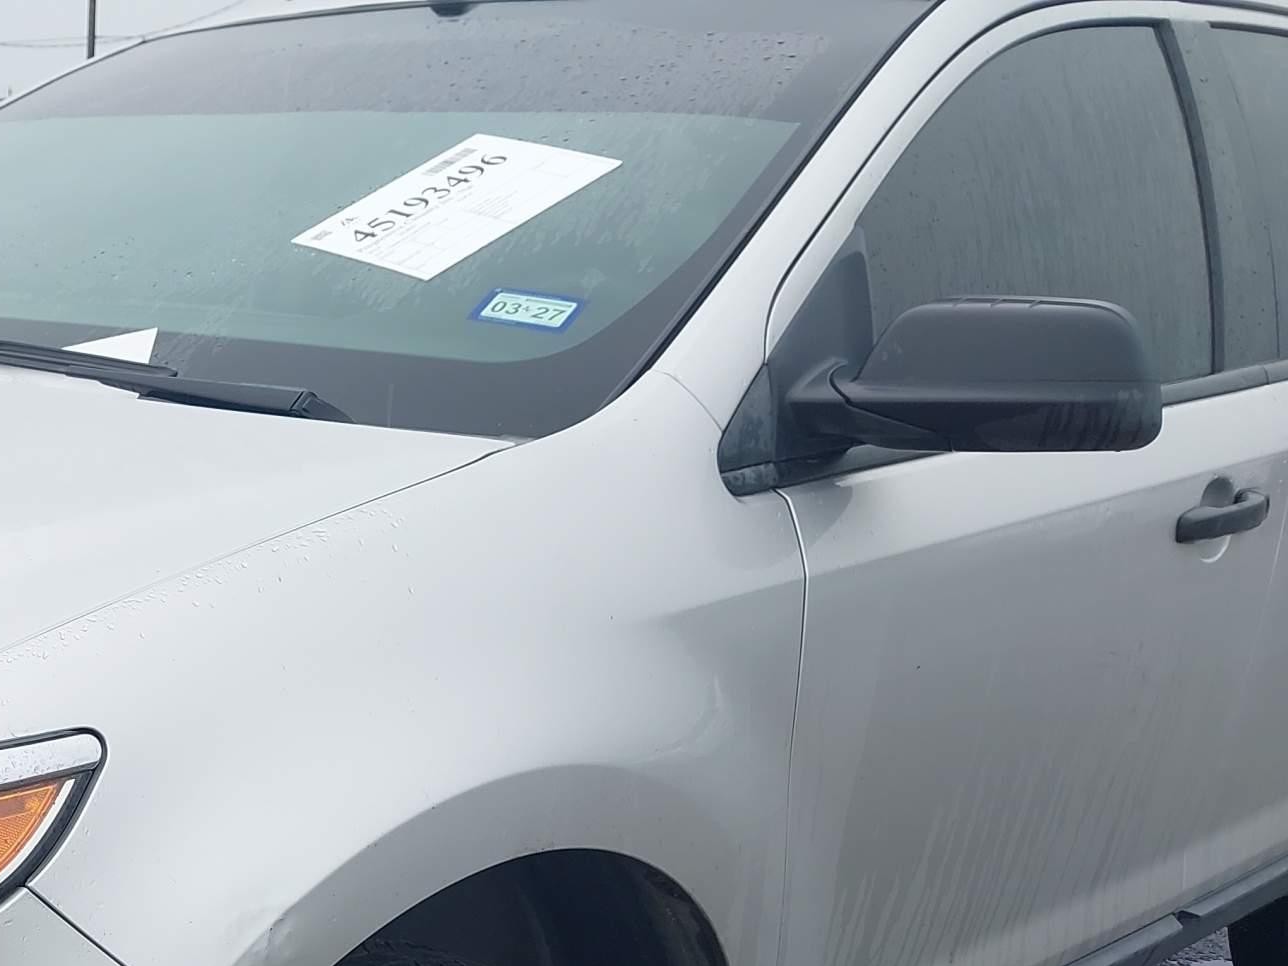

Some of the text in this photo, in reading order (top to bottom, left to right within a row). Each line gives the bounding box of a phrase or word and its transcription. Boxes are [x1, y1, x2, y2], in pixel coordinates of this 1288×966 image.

[352, 152, 508, 243] 45193496
[491, 300, 566, 321] 03 27
